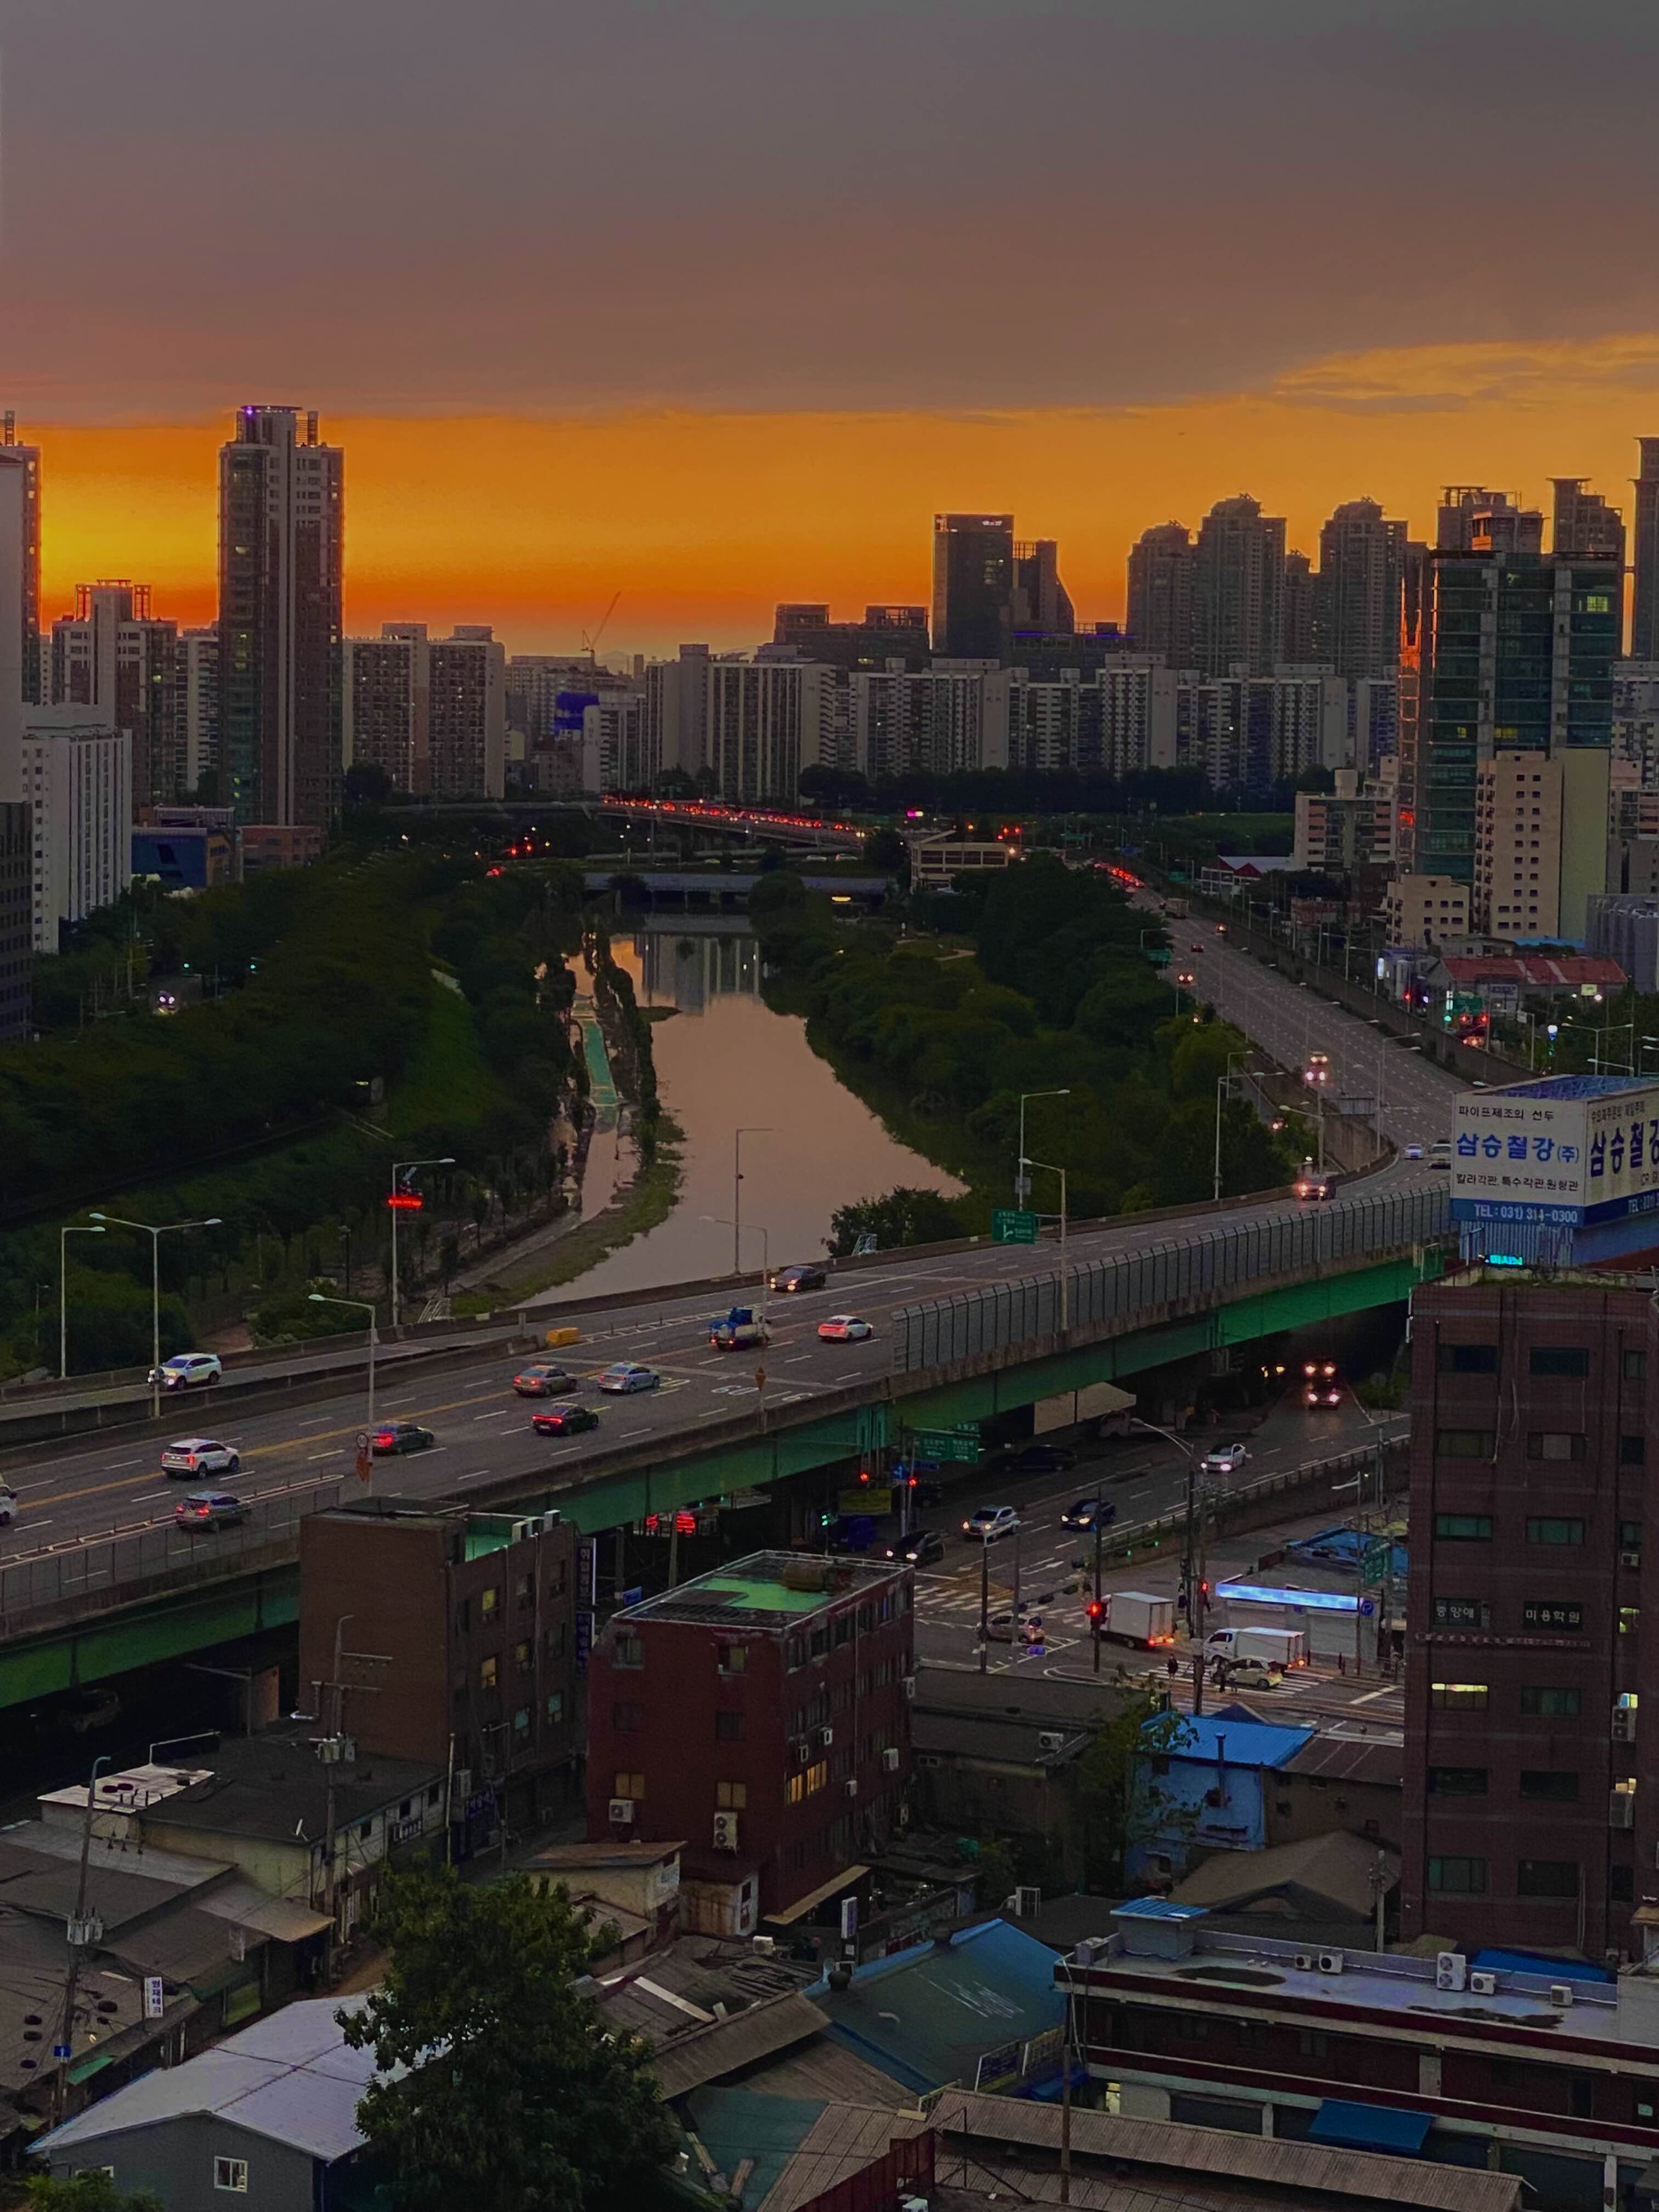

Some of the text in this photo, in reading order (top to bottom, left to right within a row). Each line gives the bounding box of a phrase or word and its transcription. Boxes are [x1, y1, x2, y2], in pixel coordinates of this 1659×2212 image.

[1459, 1105, 1554, 1121] 파이프제조의 선두
[1526, 1208, 1578, 1223] 314-0300
